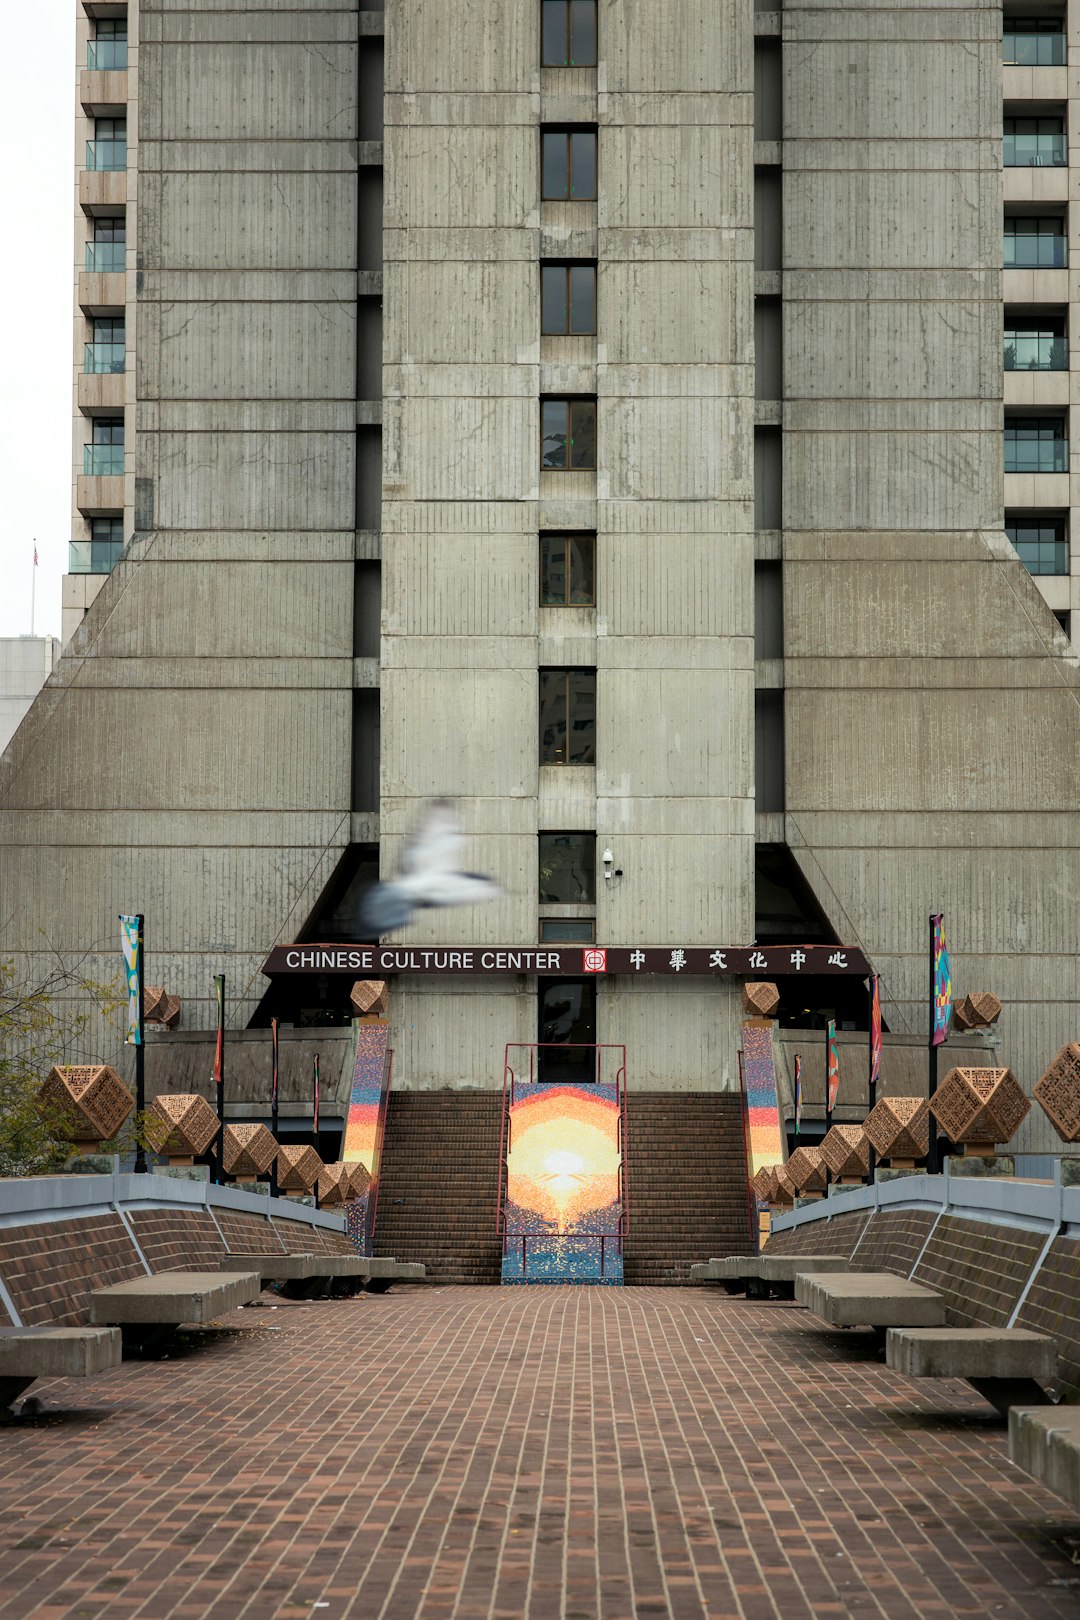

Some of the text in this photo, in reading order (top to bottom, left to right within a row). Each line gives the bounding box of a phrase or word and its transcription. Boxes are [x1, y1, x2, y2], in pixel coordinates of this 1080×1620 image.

[285, 951, 561, 969] CHINESE CULTURE CENTER
[629, 949, 849, 972] 中華文化中心
